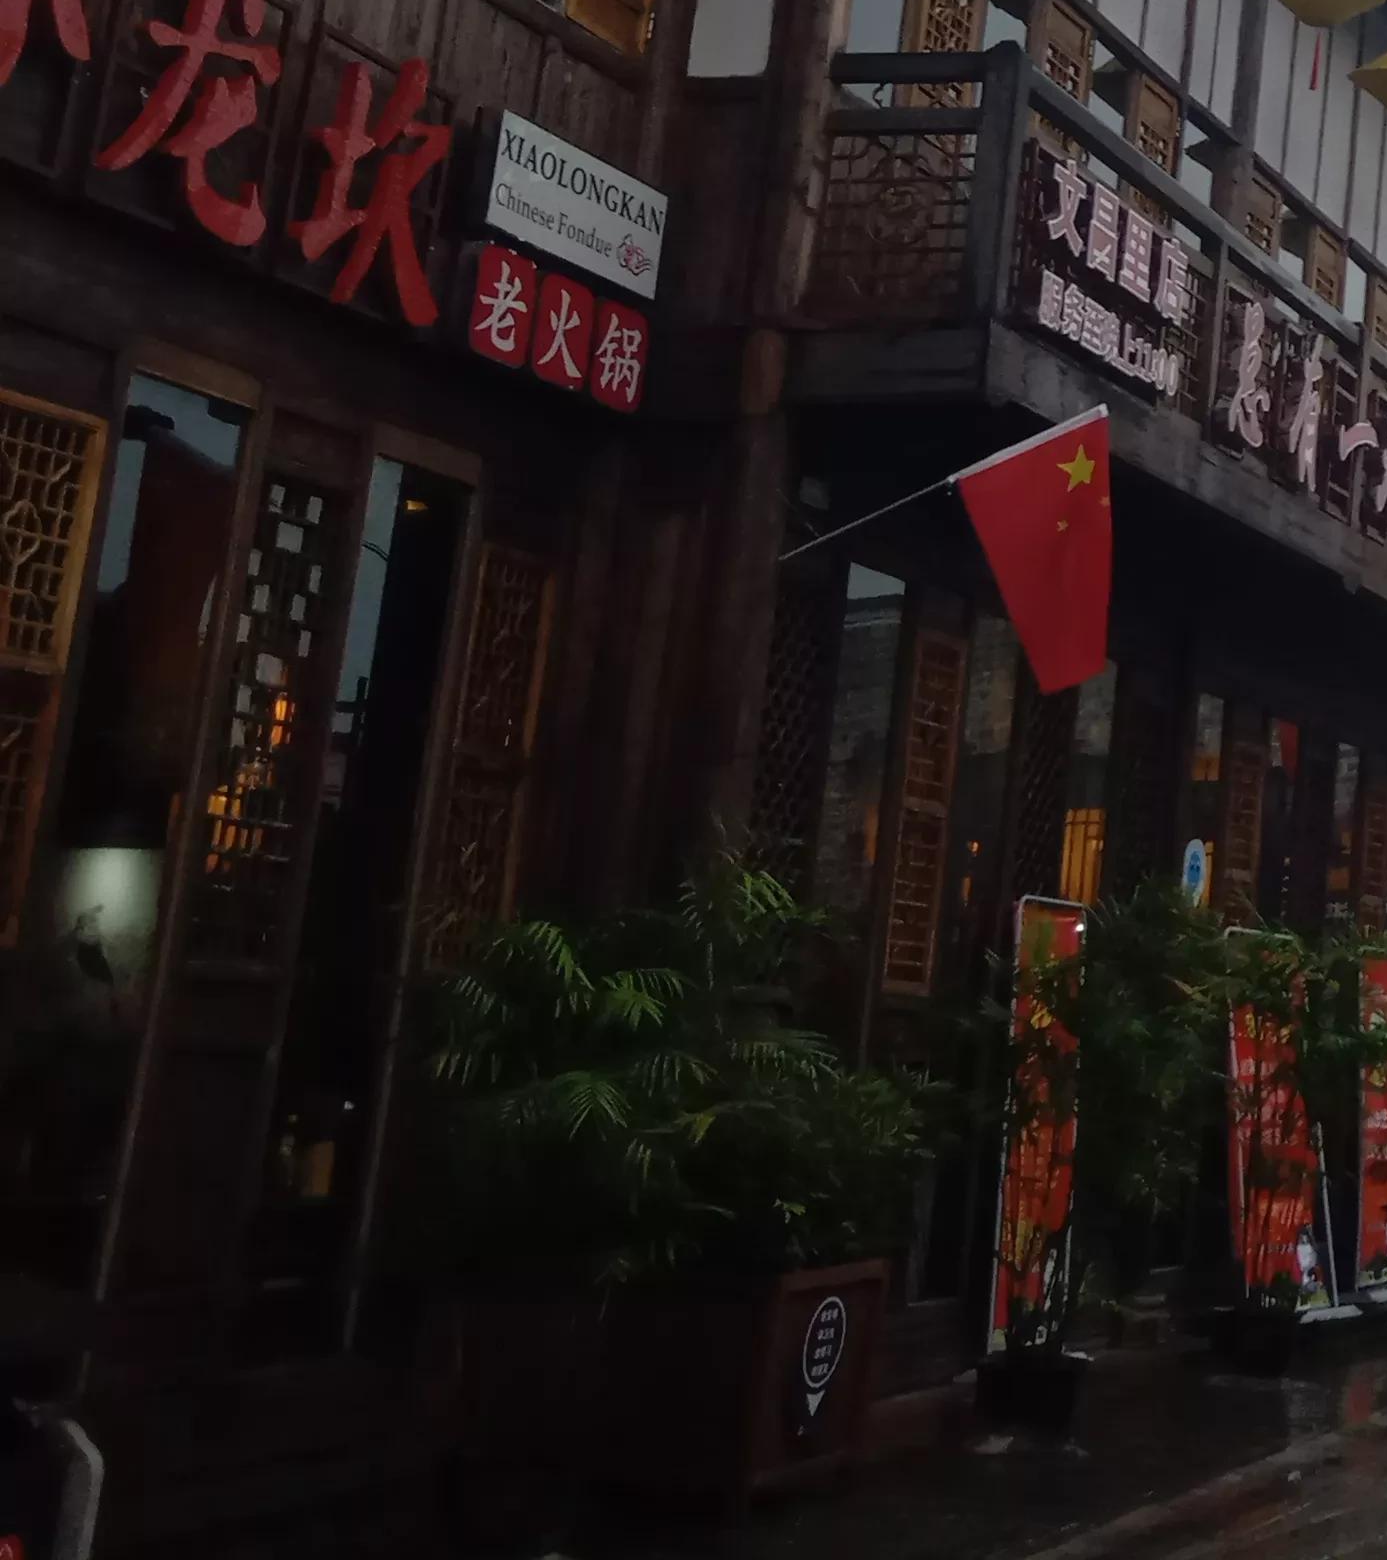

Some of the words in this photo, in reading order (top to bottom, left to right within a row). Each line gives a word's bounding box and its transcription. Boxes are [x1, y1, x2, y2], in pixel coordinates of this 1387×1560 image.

[495, 182, 556, 232] Chinese
[558, 211, 614, 259] Fondue
[500, 128, 666, 236] XIAOLONGKAN
[1047, 158, 1190, 328] 文昌里店
[474, 261, 645, 404] 老火锅
